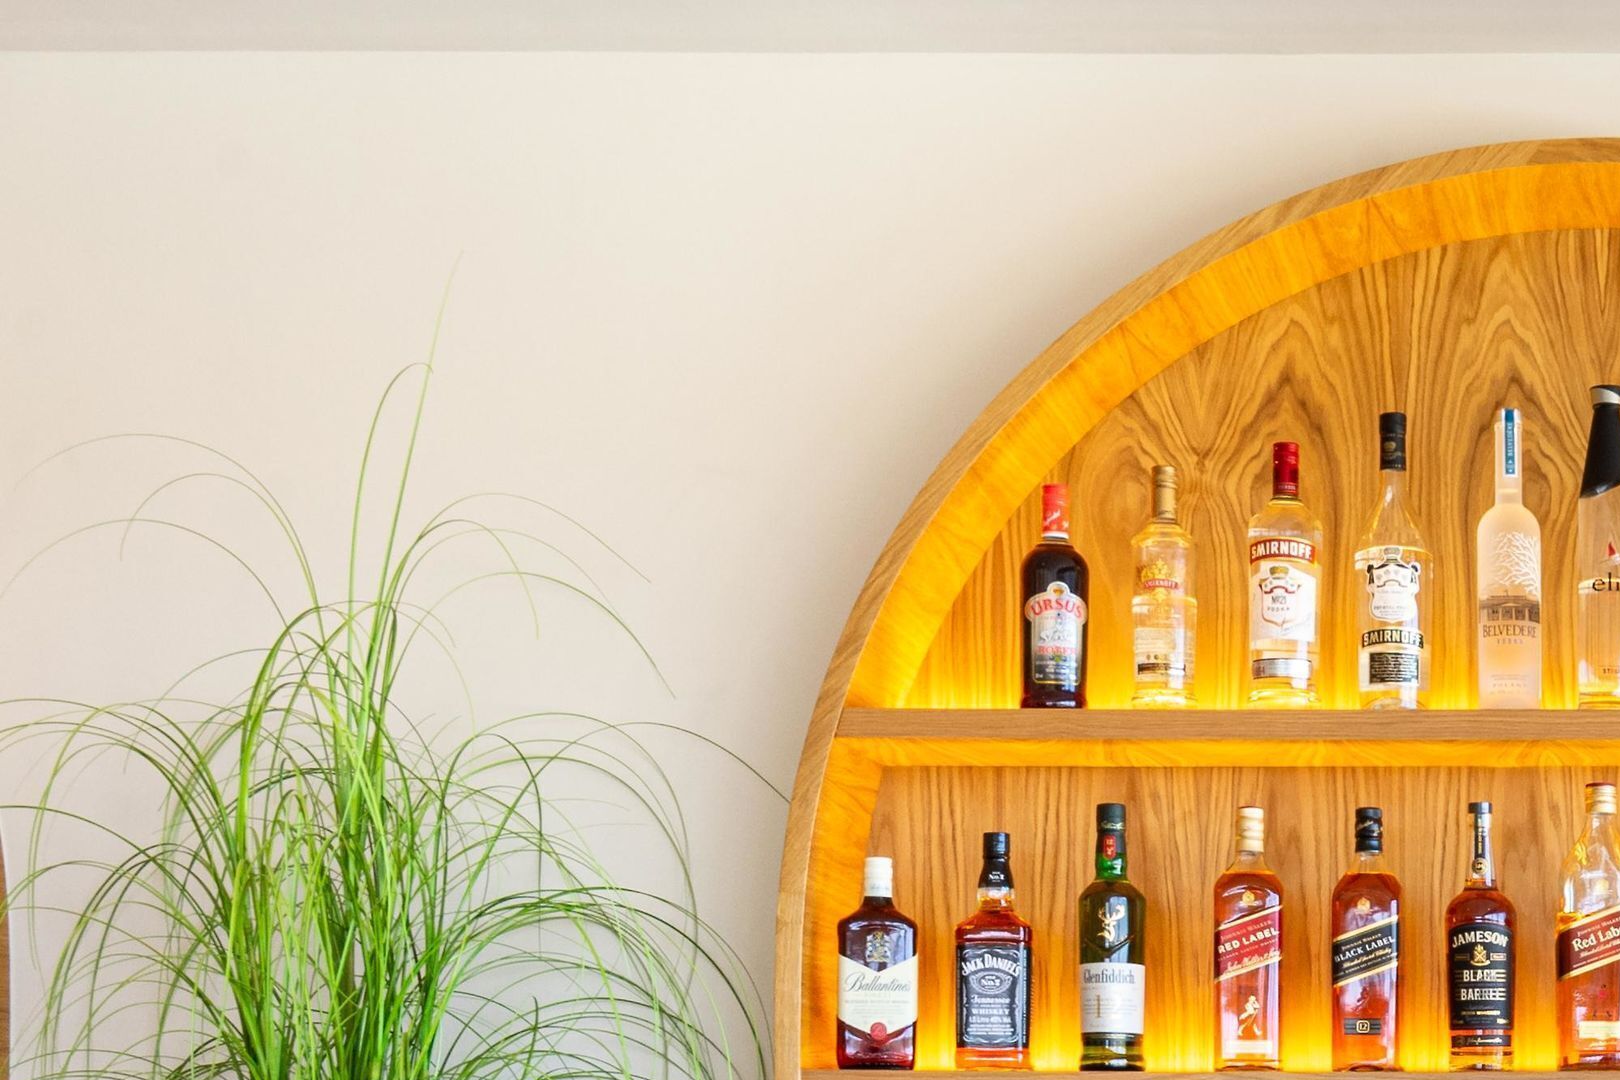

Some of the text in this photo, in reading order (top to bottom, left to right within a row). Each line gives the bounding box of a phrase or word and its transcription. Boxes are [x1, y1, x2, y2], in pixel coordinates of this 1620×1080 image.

[1030, 599, 1083, 619] URSUS
[1482, 624, 1537, 638] BELVEDERE
[1218, 938, 1240, 954] RED
[1452, 931, 1508, 948] JAMESON
[1572, 933, 1597, 951] Red
[1335, 936, 1395, 962] BLACK LABEL
[962, 957, 984, 976] JACK
[1083, 969, 1135, 985] Glenfiddich
[1463, 969, 1498, 982] BLACK
